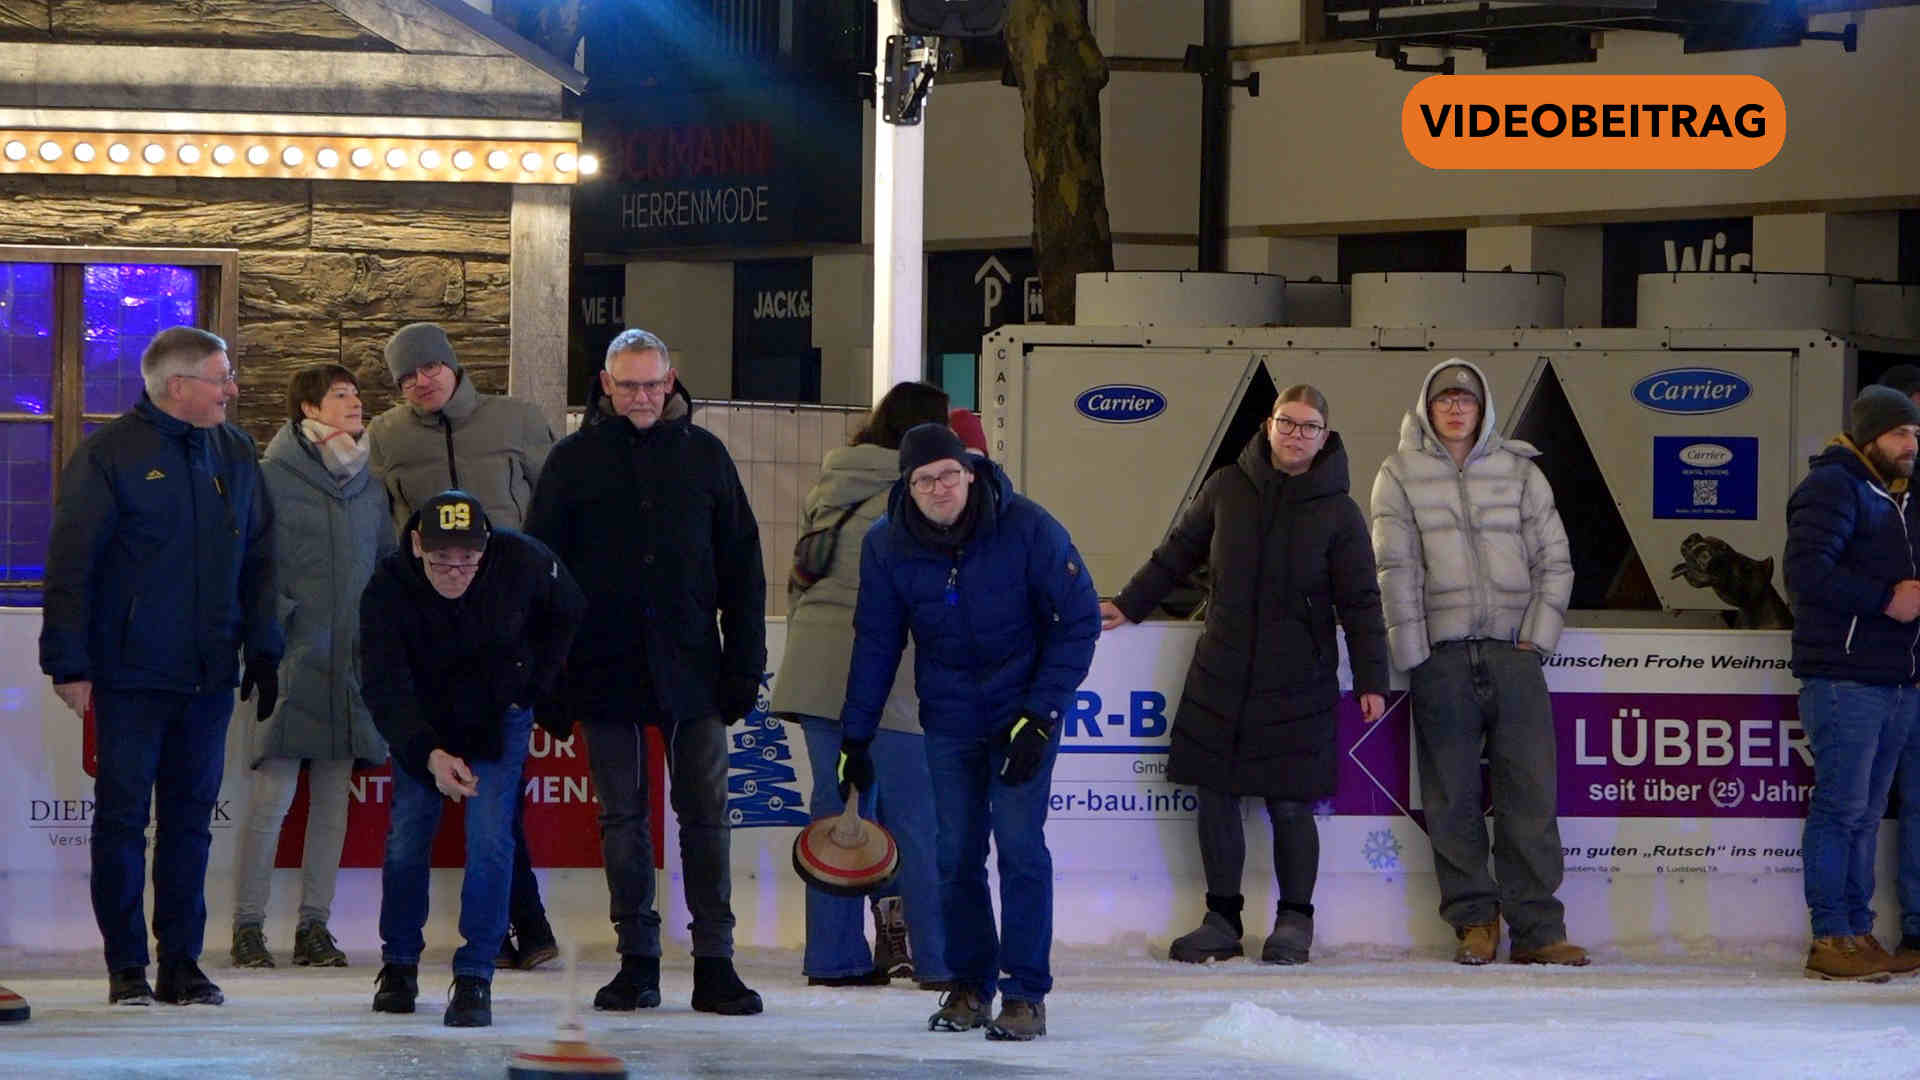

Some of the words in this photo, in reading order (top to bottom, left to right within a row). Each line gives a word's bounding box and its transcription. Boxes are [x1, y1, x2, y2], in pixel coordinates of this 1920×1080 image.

[621, 186, 769, 229] HERRENMODE
[753, 289, 813, 320] JACK&
[984, 276, 1002, 327] P
[1649, 379, 1737, 401] Carrier
[1088, 394, 1155, 411] Carrier
[1687, 449, 1727, 460] Carrier
[1644, 654, 1705, 669] Frohe
[1575, 708, 1815, 768] LÜBBER
[1589, 779, 1636, 801] seit
[1643, 779, 1702, 801] über
[1586, 846, 1638, 859] guten
[1730, 845, 1758, 857] ins
